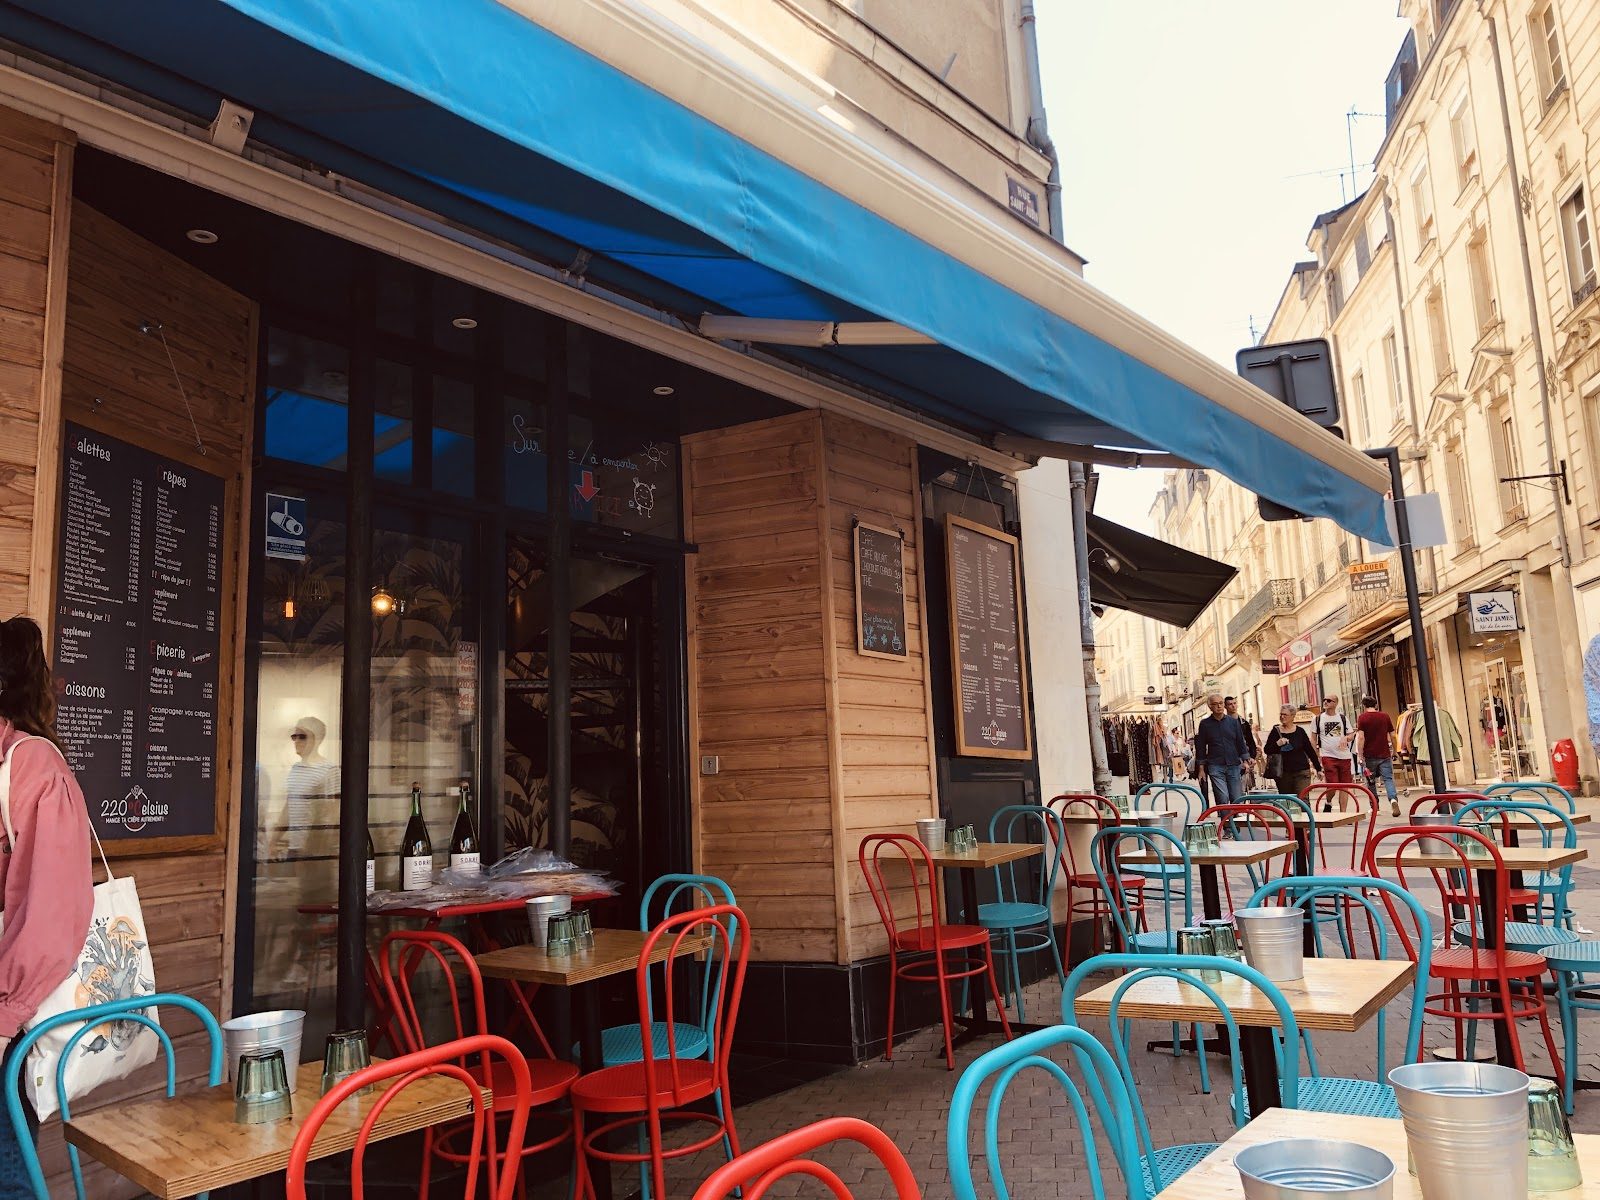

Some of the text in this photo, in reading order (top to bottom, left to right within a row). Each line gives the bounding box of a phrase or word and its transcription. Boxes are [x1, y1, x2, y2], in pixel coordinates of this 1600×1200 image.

[513, 414, 541, 453] Sur
[1361, 563, 1384, 571] LOUER
[1162, 663, 1177, 674] VIP!
